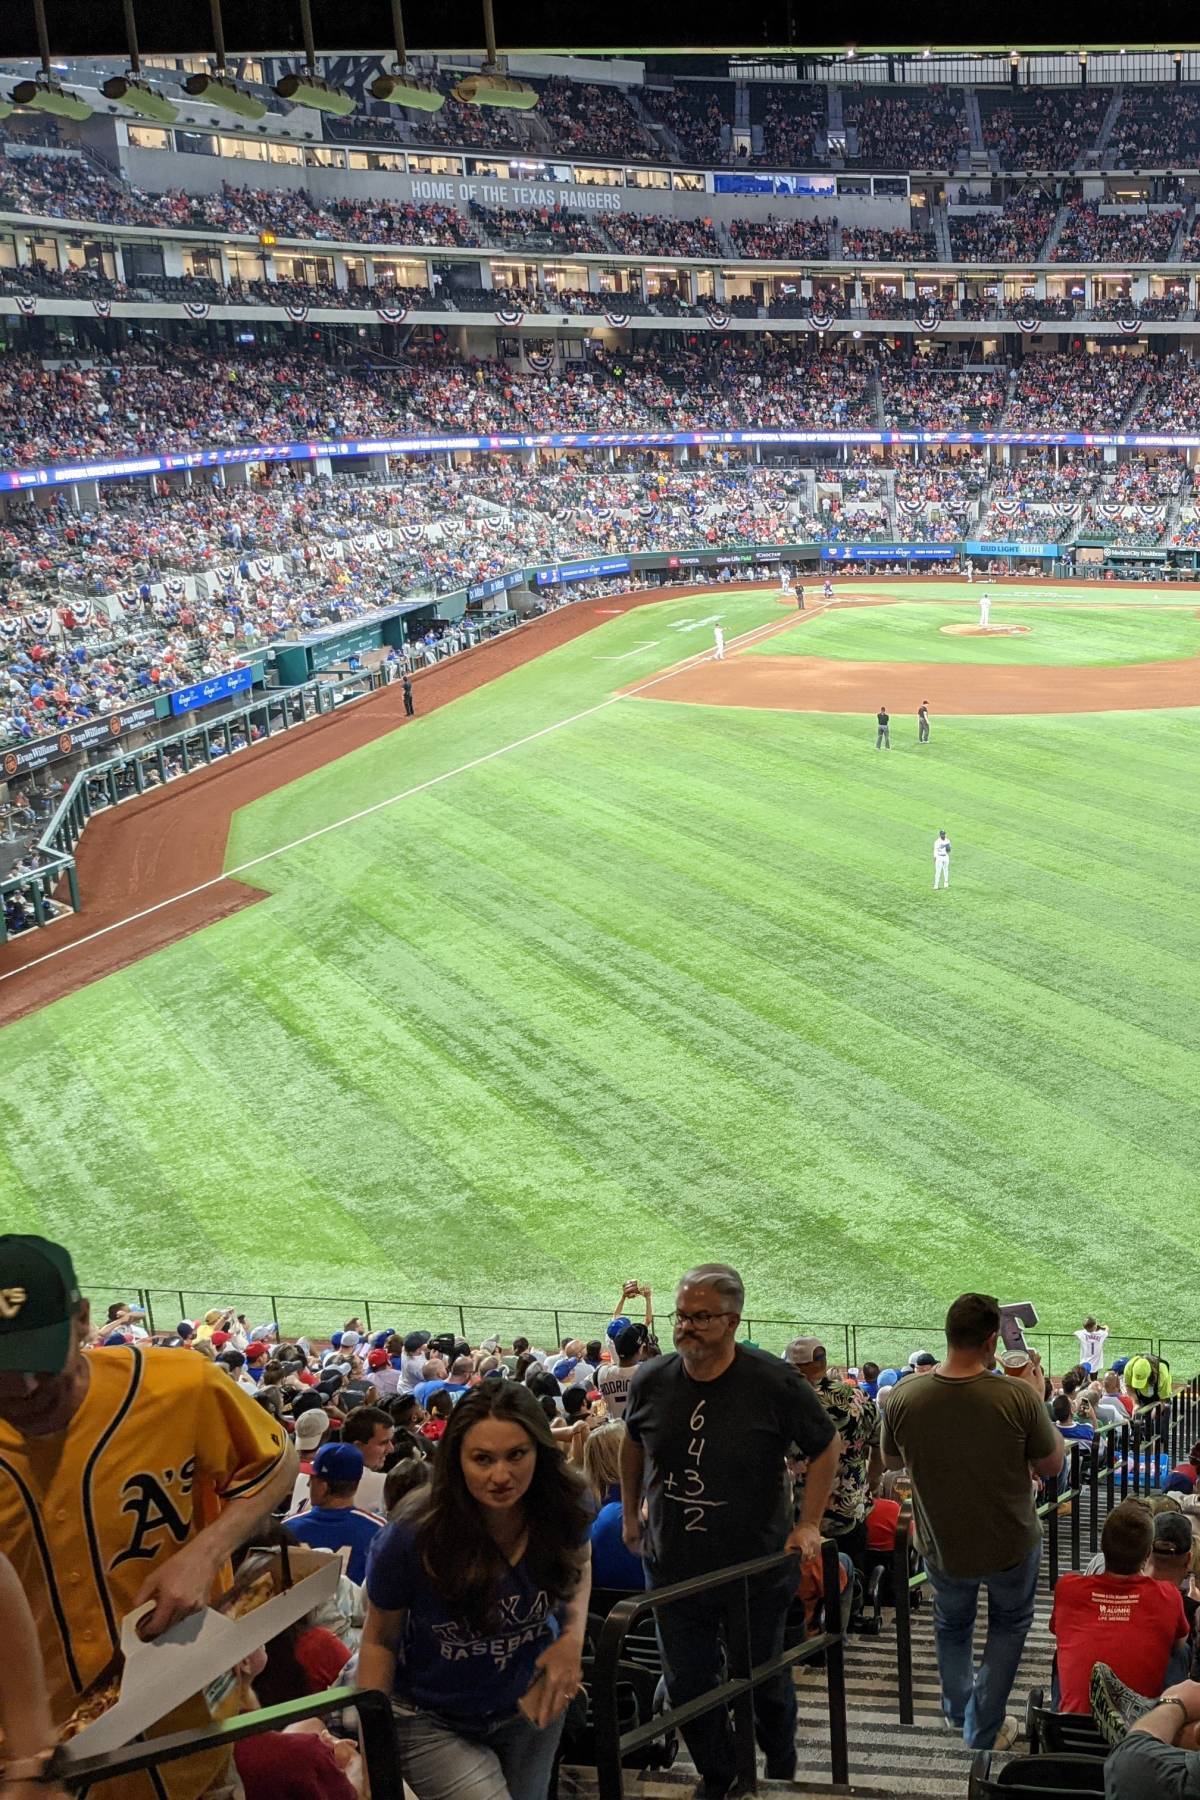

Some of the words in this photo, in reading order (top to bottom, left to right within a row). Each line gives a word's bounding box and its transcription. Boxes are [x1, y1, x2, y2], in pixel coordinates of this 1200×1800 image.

[410, 180, 455, 200] HOME
[459, 183, 476, 201] OF
[481, 185, 509, 203] THE
[512, 187, 555, 206] TEXAS
[560, 190, 621, 210] RANGERS
[998, 545, 1019, 553] LIGHT
[1090, 1342, 1095, 1355] 1
[690, 1400, 706, 1431] 6
[687, 1438, 705, 1466] 4
[684, 1507, 708, 1531] 2
